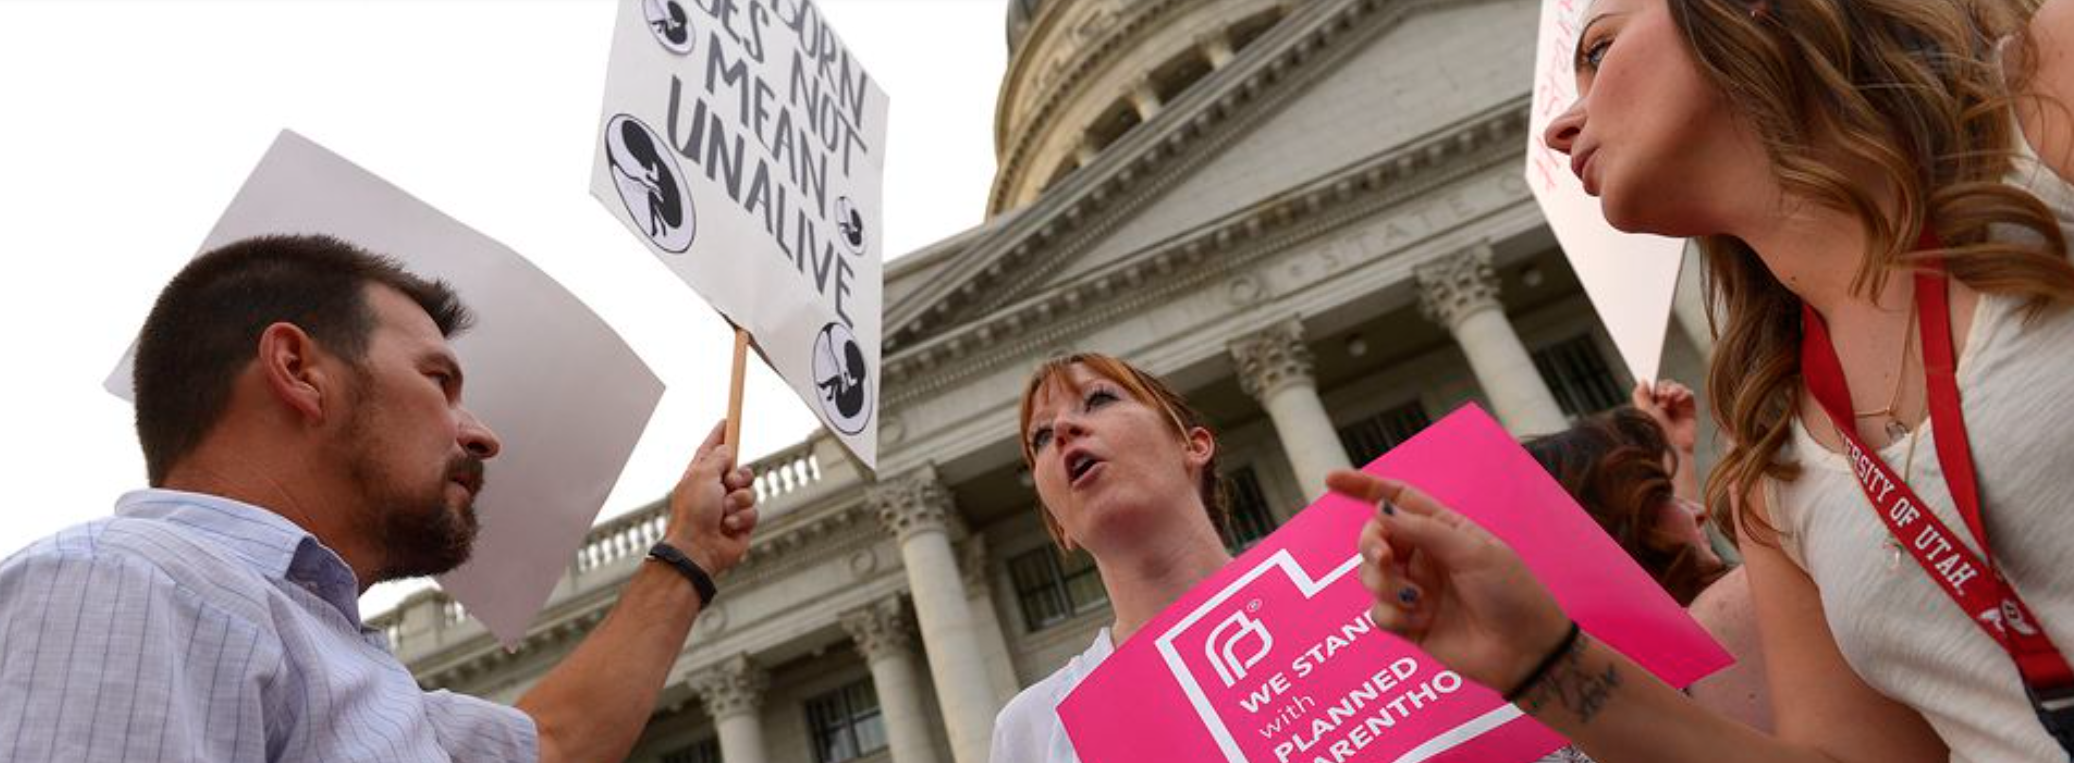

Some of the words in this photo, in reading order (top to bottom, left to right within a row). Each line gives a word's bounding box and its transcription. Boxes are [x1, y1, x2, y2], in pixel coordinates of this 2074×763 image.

[706, 31, 827, 219] MEAN
[790, 49, 867, 176] NOT
[667, 74, 853, 328] UNALIVE
[1322, 193, 1477, 267] STATE
[1889, 497, 1921, 528] OF
[1239, 671, 1292, 714] WE
[1259, 694, 1316, 739] with
[1273, 656, 1419, 763] PLANNED
[1312, 670, 1463, 763] RENTHO
